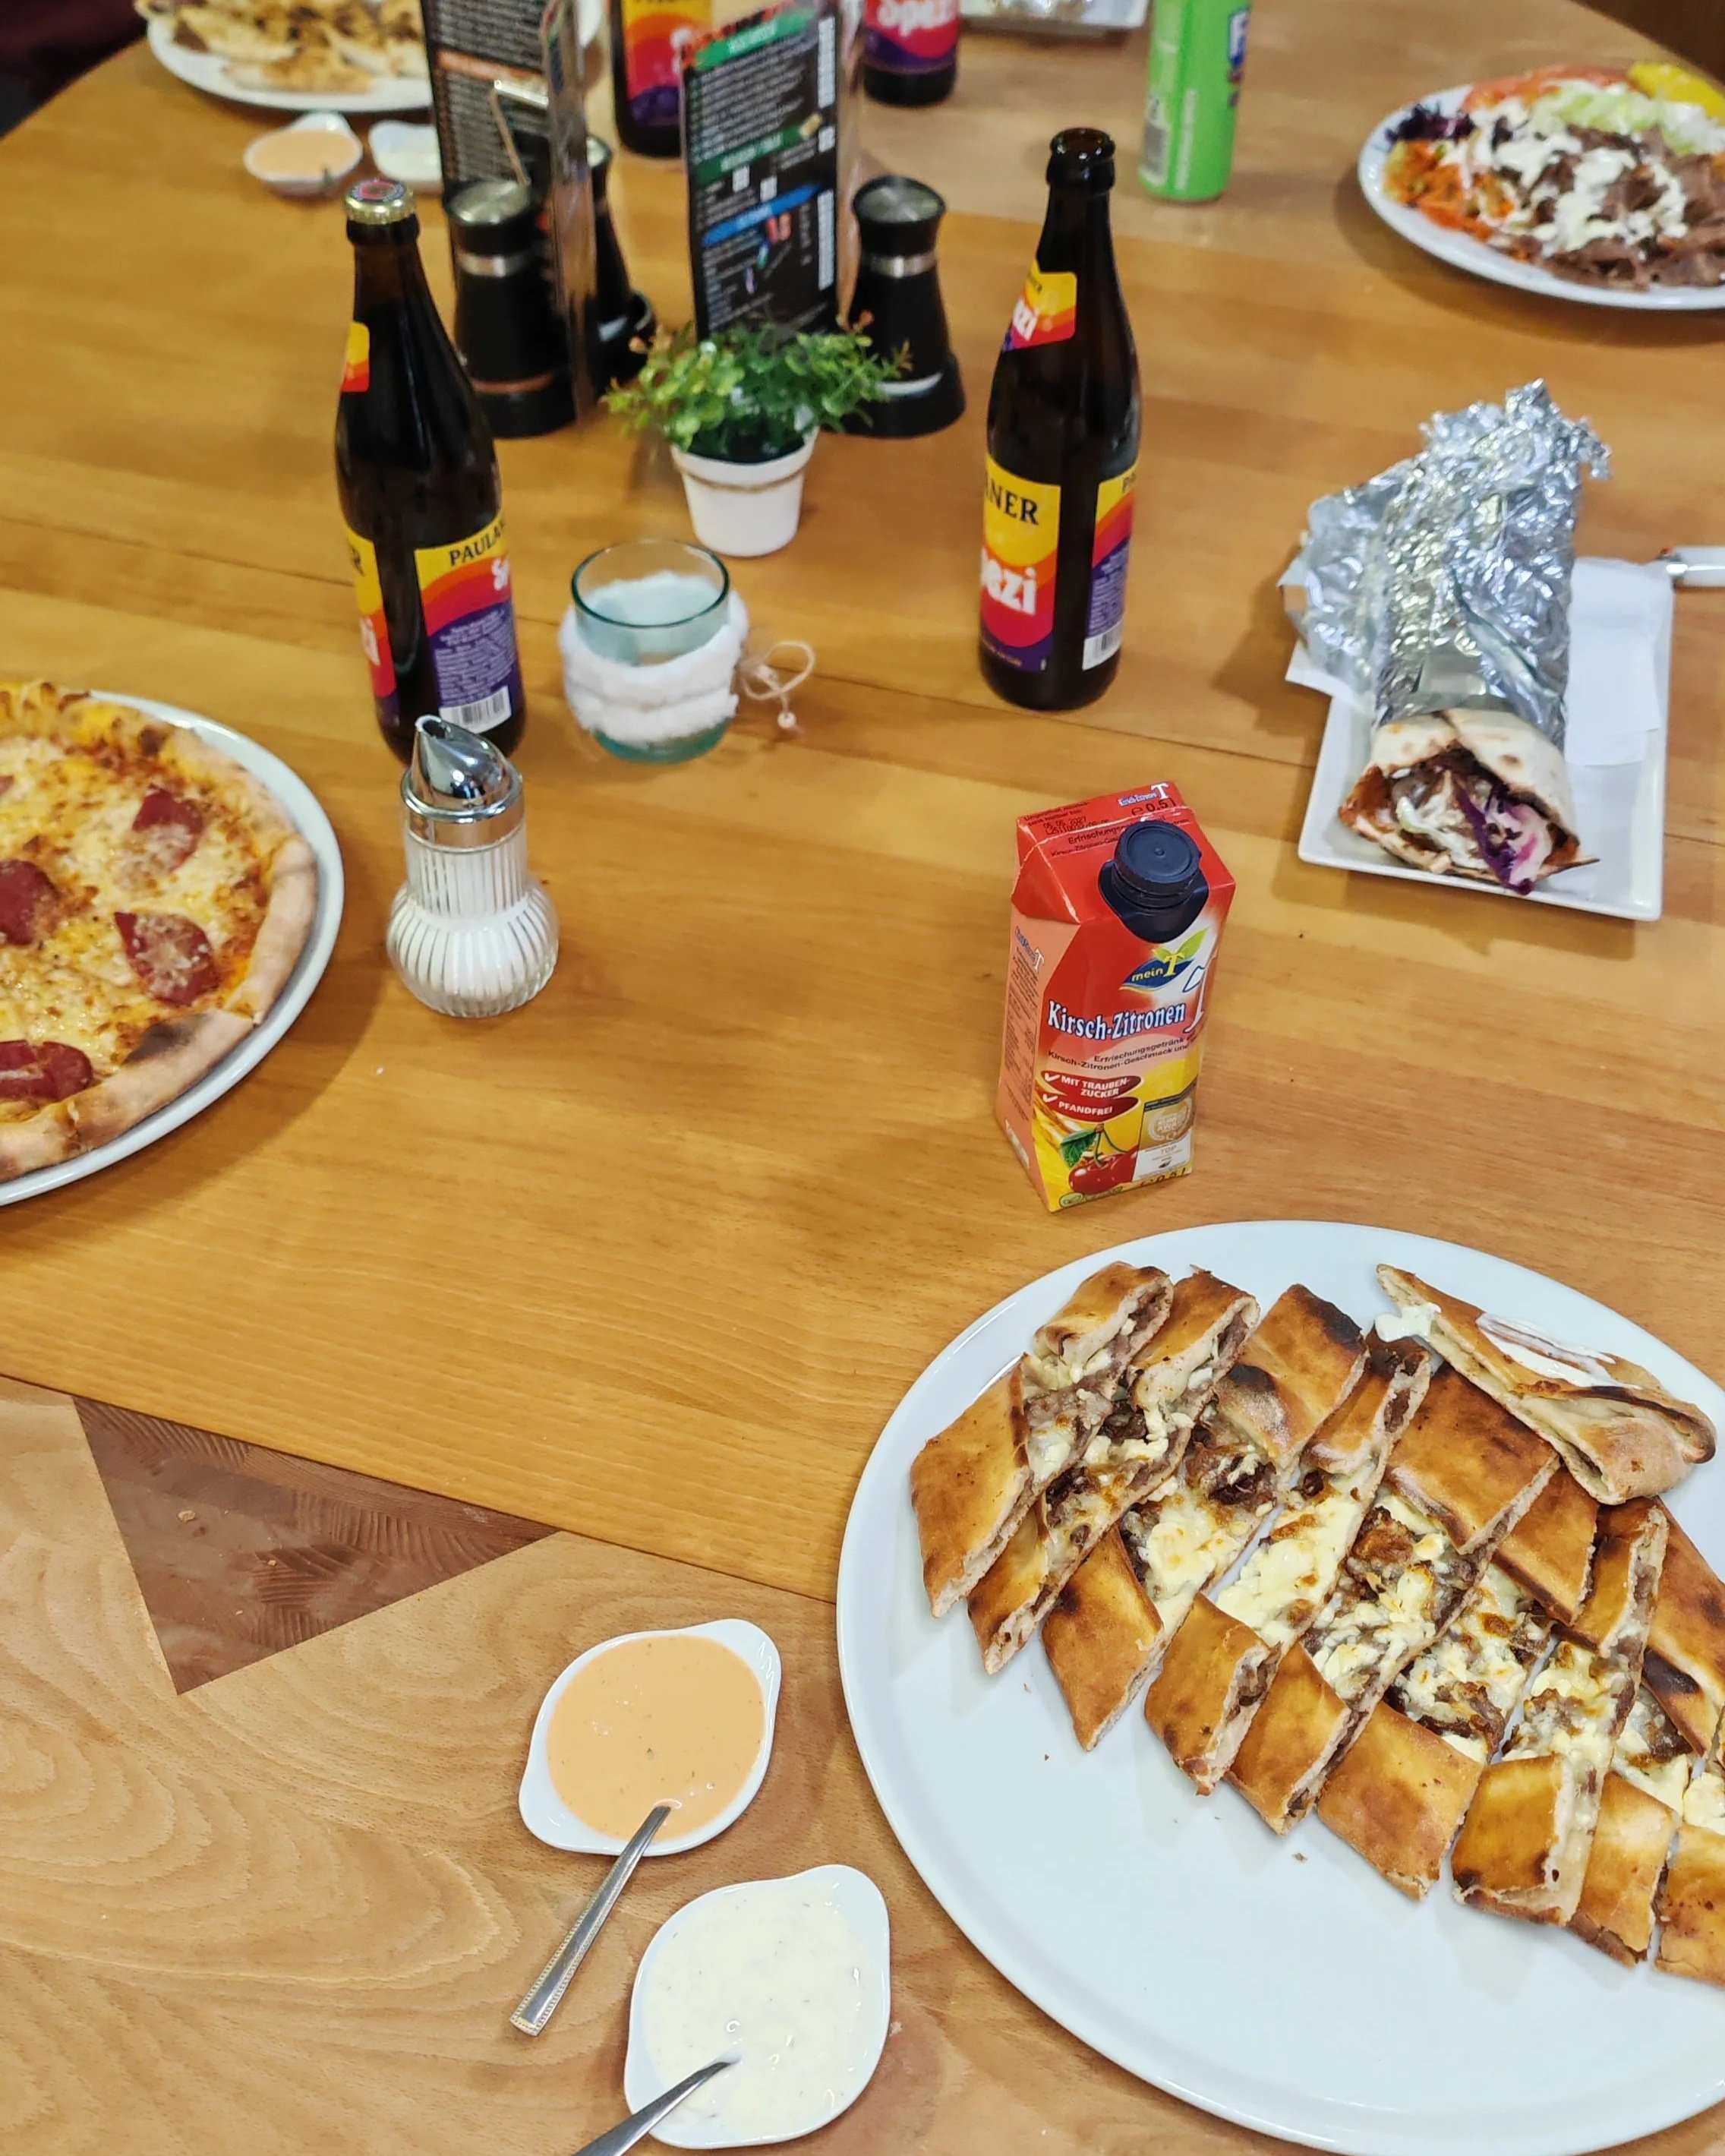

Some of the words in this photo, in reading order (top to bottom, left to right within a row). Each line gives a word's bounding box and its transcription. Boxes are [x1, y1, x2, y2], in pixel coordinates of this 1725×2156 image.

[985, 477, 1039, 526] NER
[1047, 999, 1186, 1041] Kirsch-Zitronen
[1093, 1037, 1184, 1063] Erfrischungsgetränk
[1061, 1075, 1080, 1087] MIT
[1080, 1087, 1120, 1099] ZUCKER
[1058, 1100, 1113, 1116] PFANDFREI
